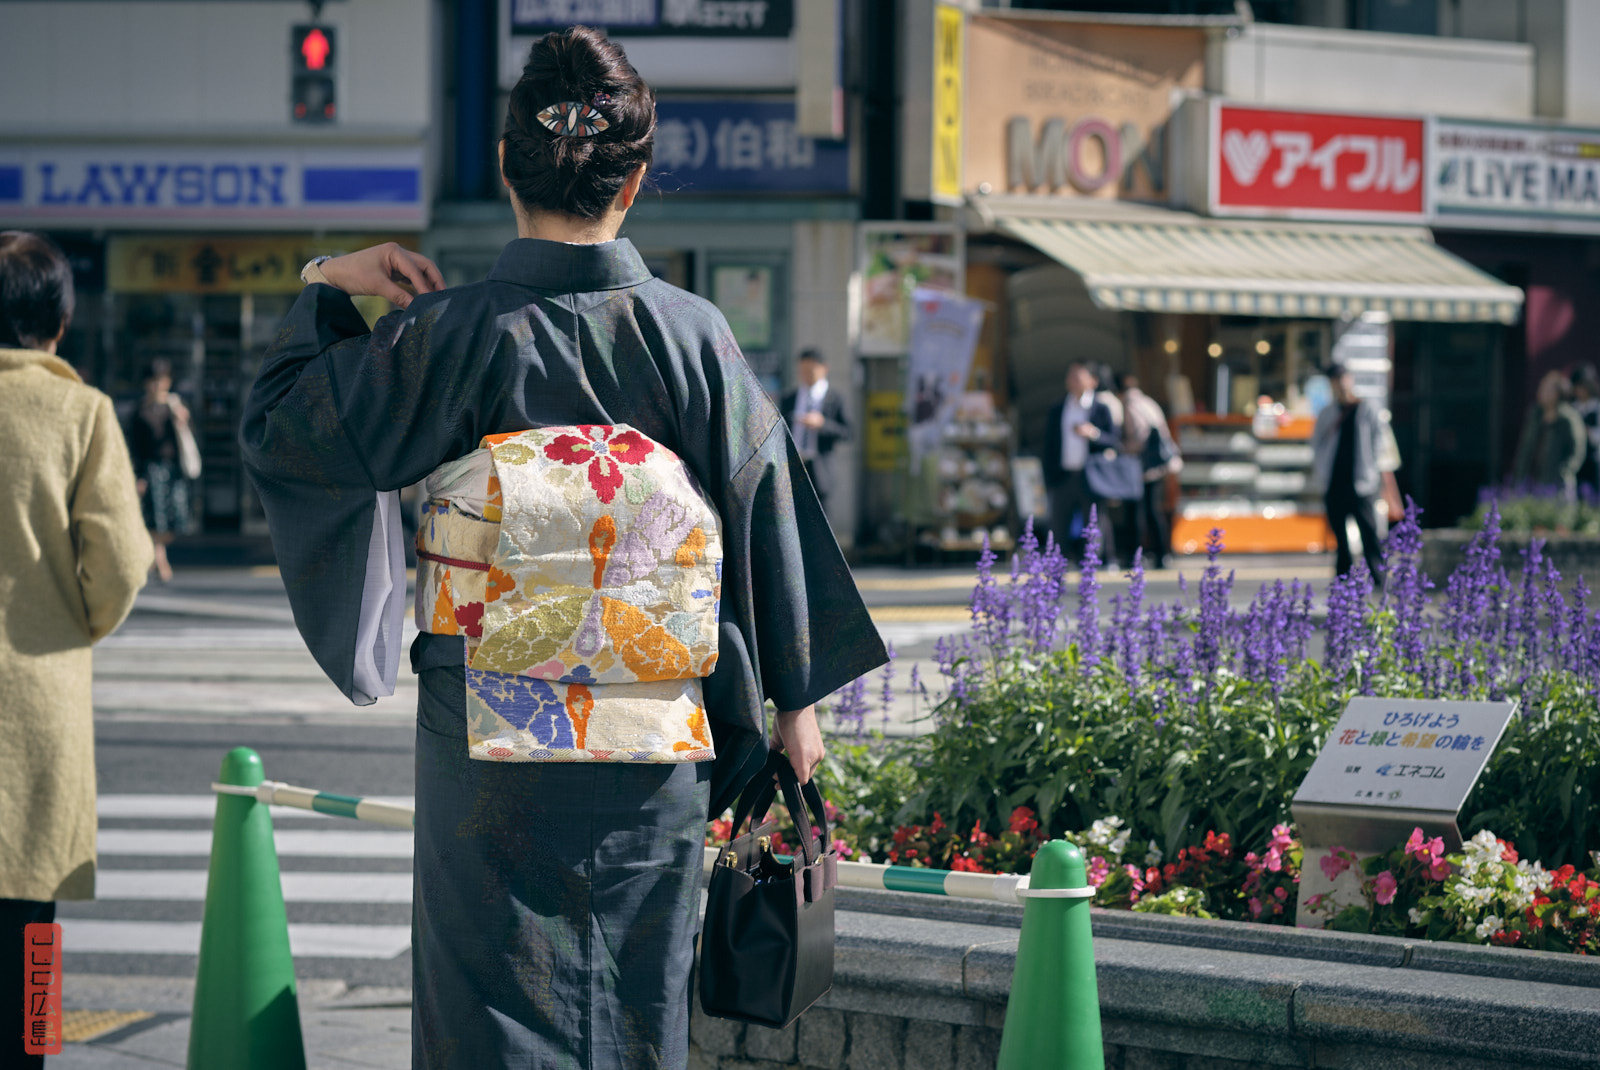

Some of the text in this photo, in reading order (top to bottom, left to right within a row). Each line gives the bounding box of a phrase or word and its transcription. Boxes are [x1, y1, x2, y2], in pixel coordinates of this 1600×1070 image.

[1006, 114, 1165, 193] MON
[1272, 130, 1420, 194] アイフル
[38, 163, 287, 205] LAWSON
[1383, 711, 1460, 729] ひろげよう
[1338, 728, 1485, 751] 花と緑と希望の輪を
[1394, 764, 1446, 779] エネコム
